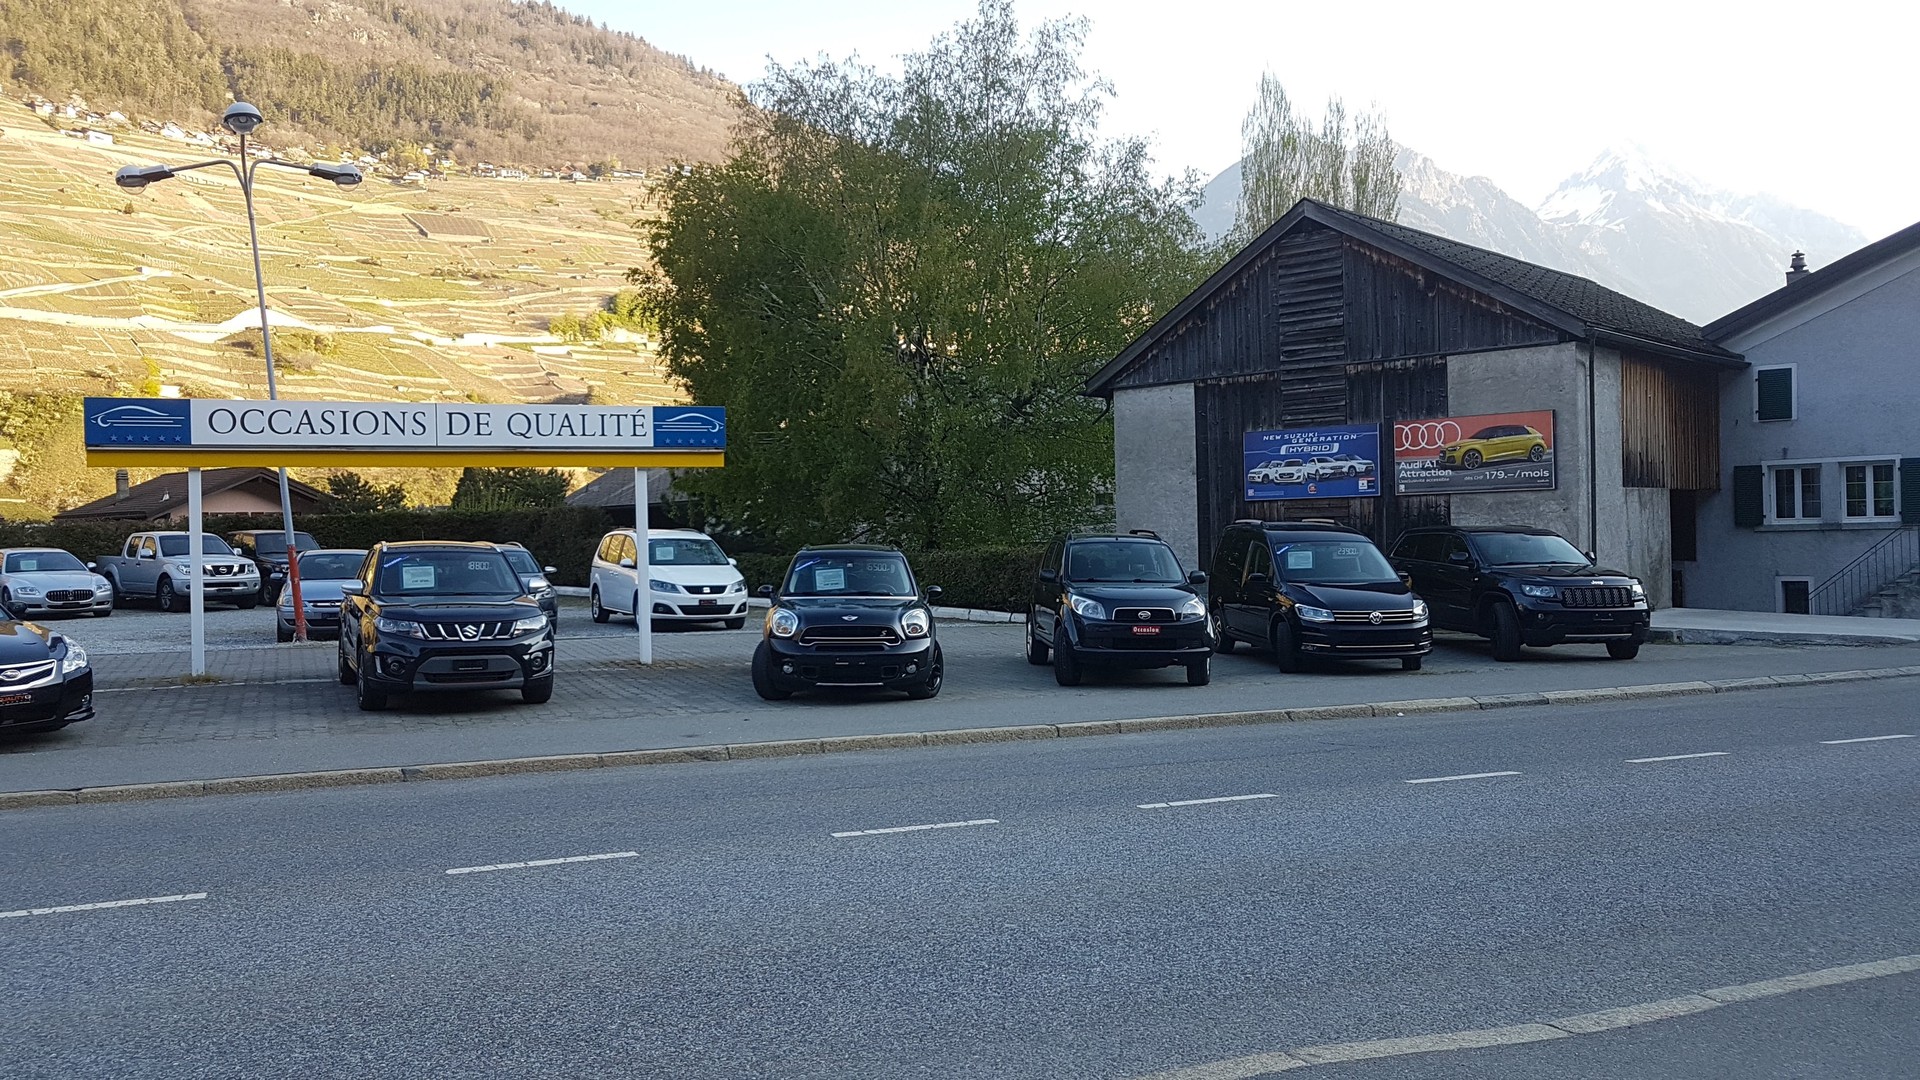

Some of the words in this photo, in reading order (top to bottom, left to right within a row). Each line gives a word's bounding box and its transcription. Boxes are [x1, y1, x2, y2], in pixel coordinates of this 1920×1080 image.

[208, 408, 427, 436] OCCASIONS
[446, 411, 493, 436] DE
[507, 409, 648, 439] QUALITÉ
[1284, 432, 1318, 440] SUZUKI
[1292, 434, 1357, 444] GENERATION
[1289, 444, 1330, 453] HYBRID
[1399, 461, 1422, 469] Audi
[1424, 460, 1437, 468] A1
[1399, 469, 1452, 478] Attraction
